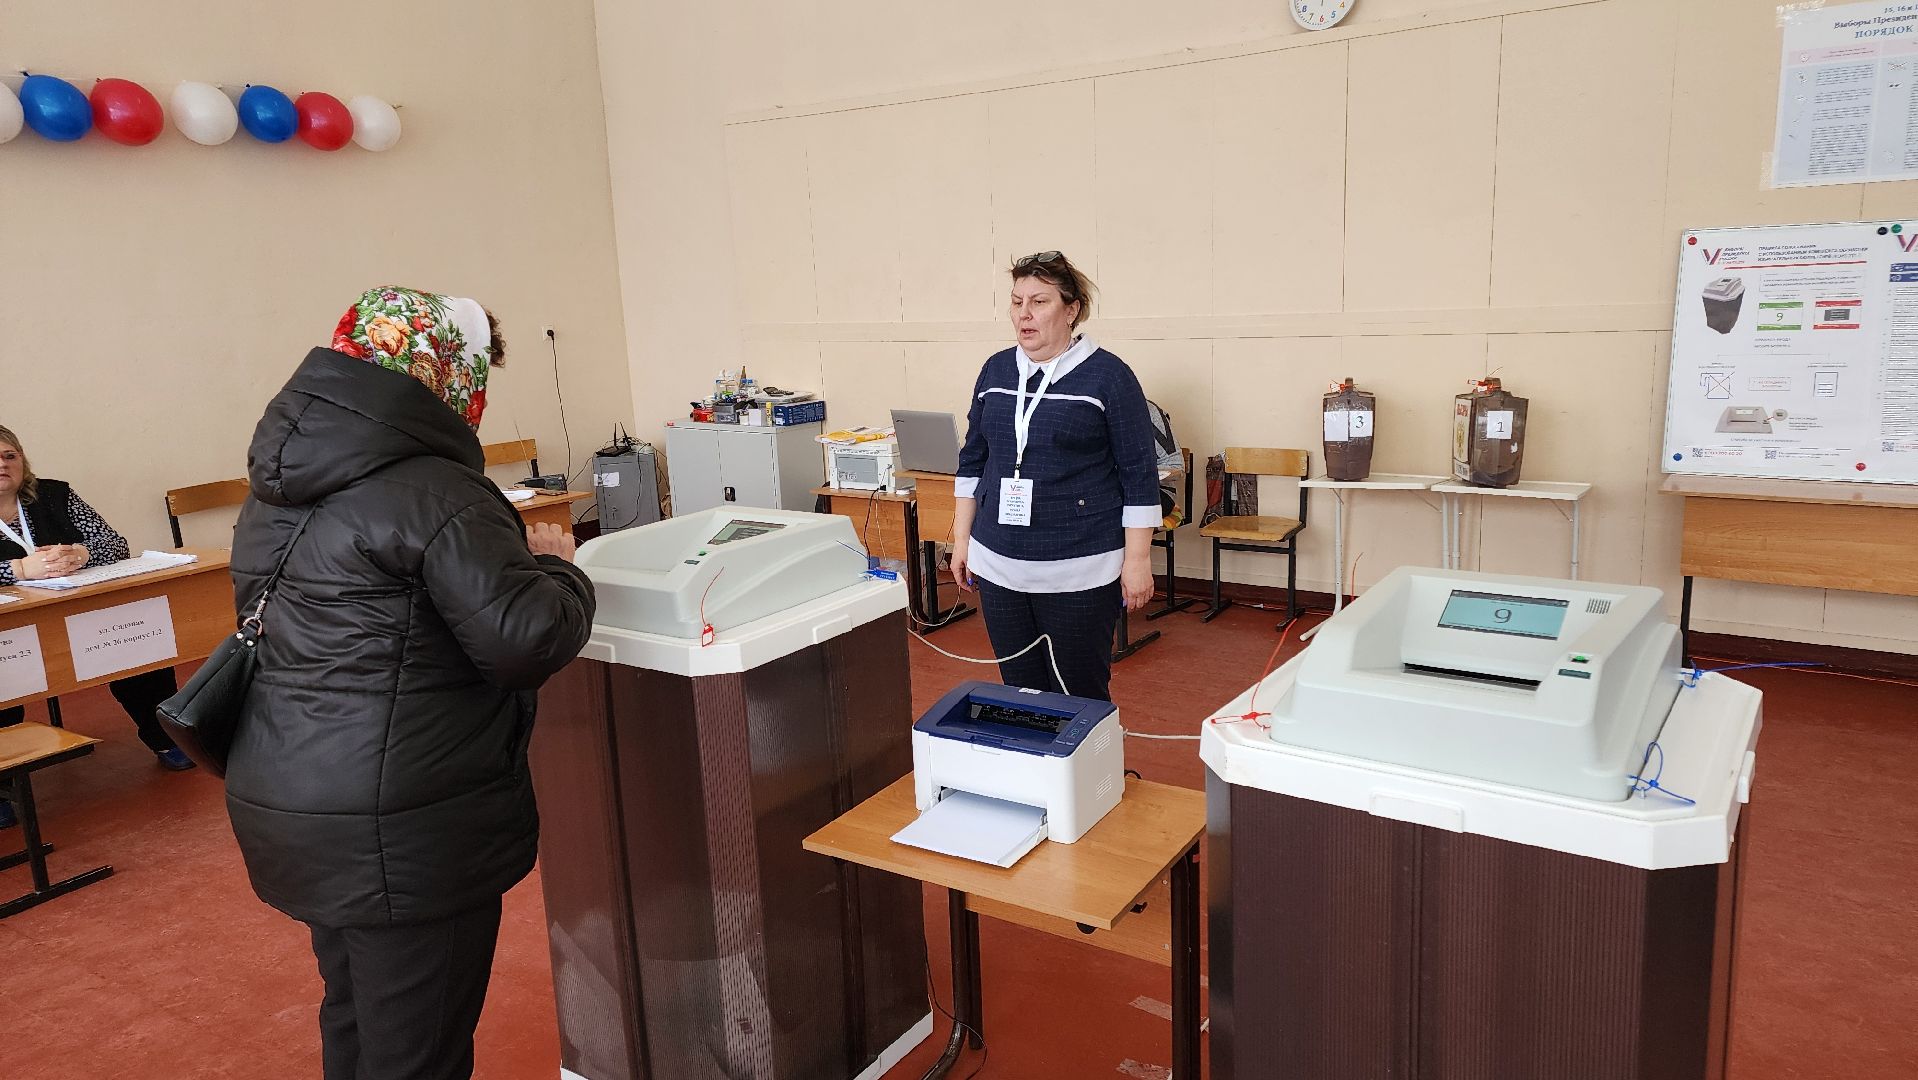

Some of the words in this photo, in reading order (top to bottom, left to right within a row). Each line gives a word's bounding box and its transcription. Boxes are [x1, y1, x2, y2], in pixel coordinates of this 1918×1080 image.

[1320, 14, 1324, 22] 6
[1834, 20, 1872, 29] Выборы
[1855, 25, 1914, 38] ПОРЯДОК
[1776, 312, 1783, 321] 9
[1355, 415, 1364, 428] 3
[1495, 421, 1504, 432] 1
[1494, 608, 1512, 624] 9
[124, 632, 150, 643] корпус
[152, 628, 162, 636] 1,2
